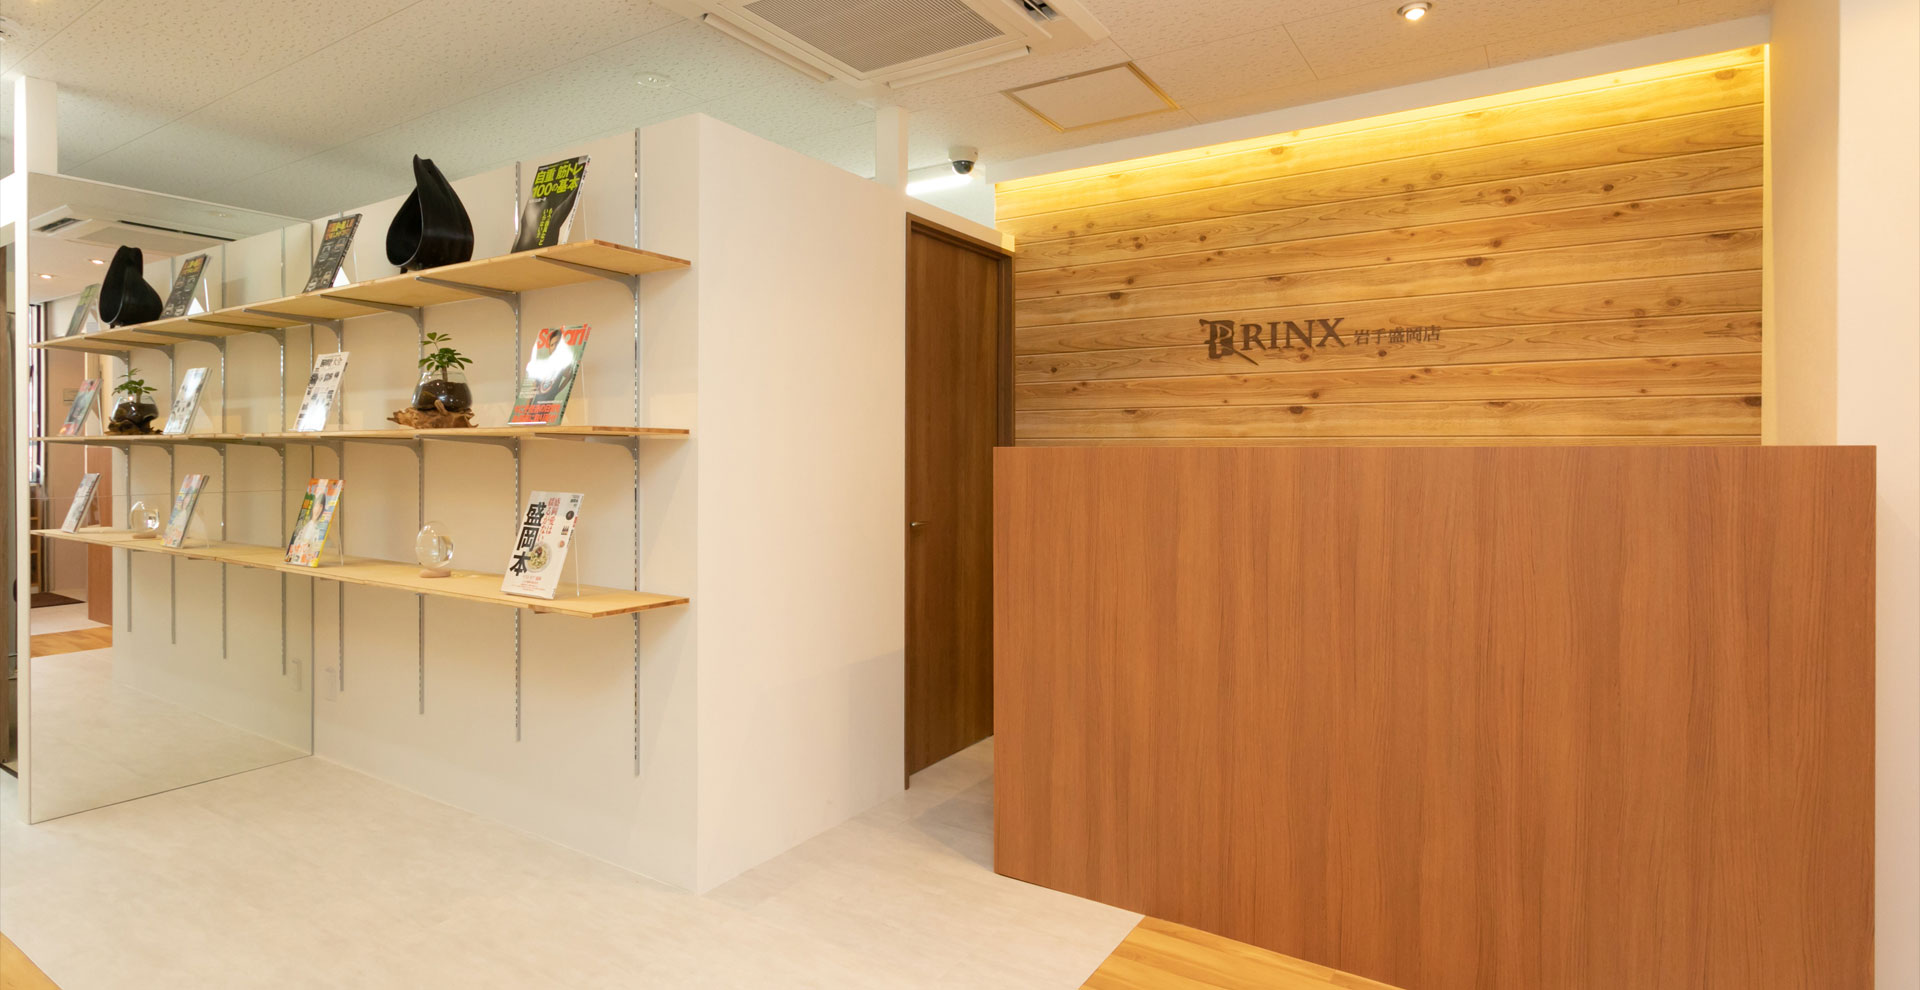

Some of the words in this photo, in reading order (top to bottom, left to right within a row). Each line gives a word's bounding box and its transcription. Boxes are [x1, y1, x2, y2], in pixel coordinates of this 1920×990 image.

[532, 175, 580, 199] 100の基本
[1239, 318, 1346, 351] RINX
[1353, 324, 1441, 345] 岩手盛岡店
[509, 501, 547, 576] 盛岡本
